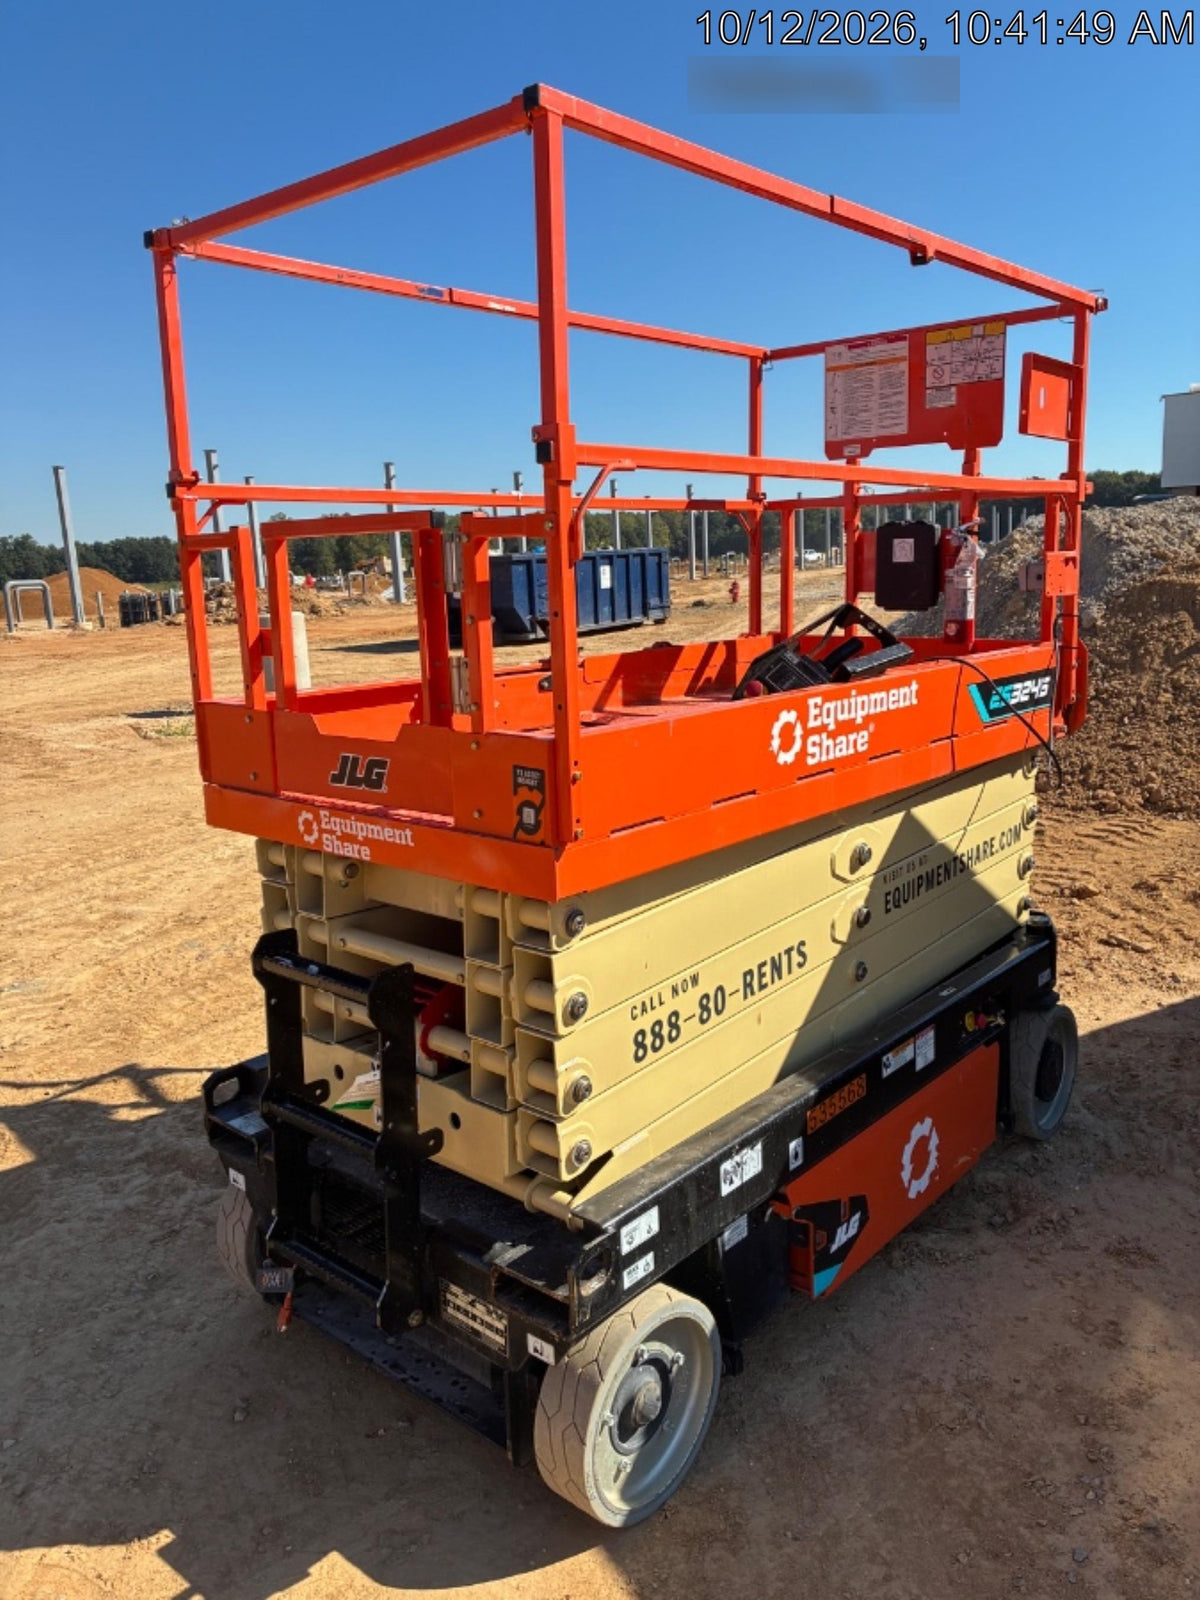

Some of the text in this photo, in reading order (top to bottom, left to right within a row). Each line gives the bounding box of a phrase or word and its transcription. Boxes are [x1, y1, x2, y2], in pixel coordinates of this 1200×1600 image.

[807, 680, 919, 731] Equipment
[329, 752, 390, 793] JLG
[319, 809, 415, 847] Equipment
[322, 833, 371, 861] Share
[884, 823, 1022, 914] EQUIPMENTSHARE.COM
[630, 972, 700, 1021] CALL NOW
[633, 940, 808, 1063] 888-80-RENTS
[830, 1210, 861, 1254] JLG
